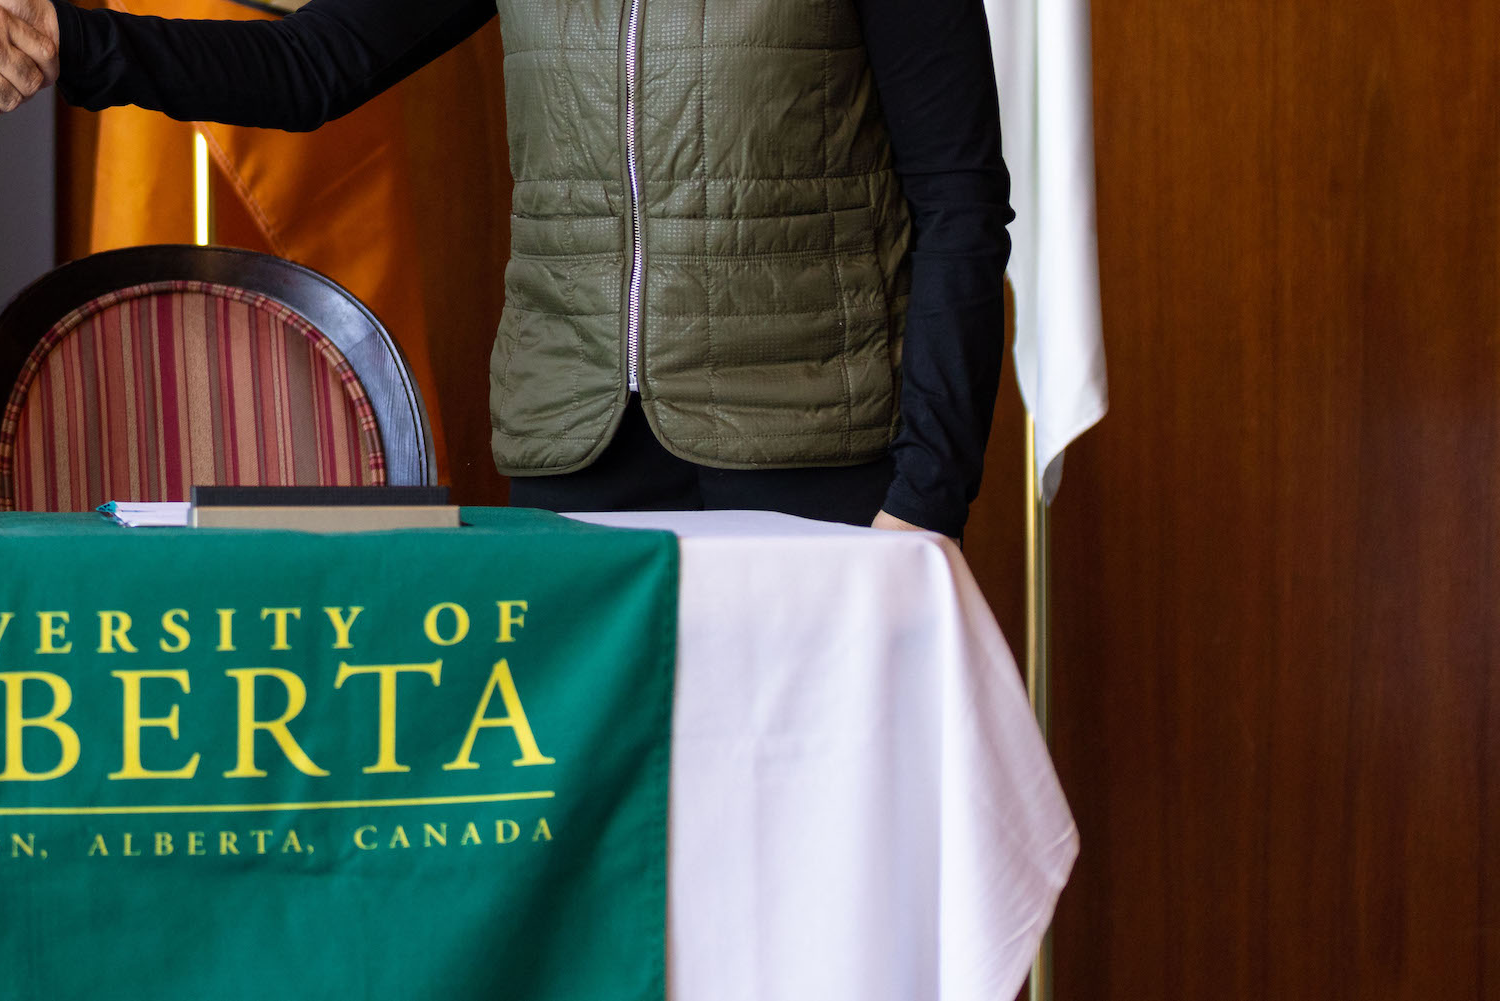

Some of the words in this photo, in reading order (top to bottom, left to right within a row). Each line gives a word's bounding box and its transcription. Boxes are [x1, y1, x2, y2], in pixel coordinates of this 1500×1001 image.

[423, 600, 529, 646] OF
[88, 830, 315, 858] ALBERTA,
[354, 818, 555, 850] CANADA
